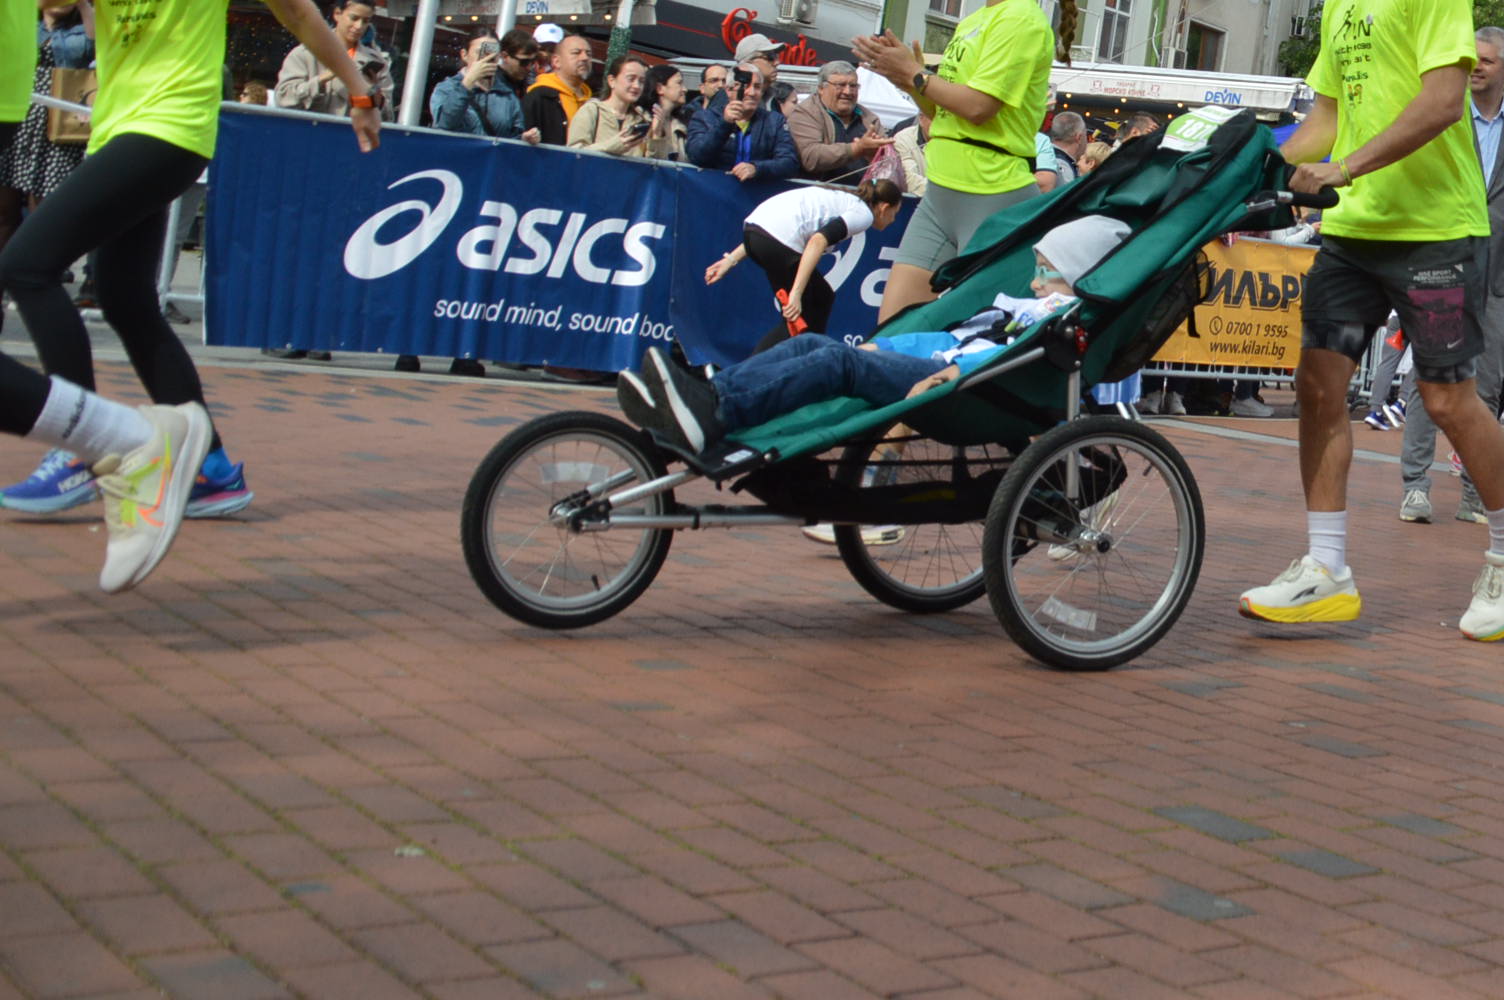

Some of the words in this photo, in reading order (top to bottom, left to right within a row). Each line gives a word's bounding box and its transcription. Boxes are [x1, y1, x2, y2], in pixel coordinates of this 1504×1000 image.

[1204, 89, 1243, 105] DEVIN
[1199, 263, 1302, 312] ИЛЪР
[434, 298, 503, 323] sound
[504, 302, 563, 332] mind,
[569, 312, 639, 335] sound
[1226, 321, 1253, 336] 0700
[1256, 323, 1261, 336] 1
[1264, 325, 1289, 338] 9595
[1210, 339, 1286, 359] www.kilari.bg
